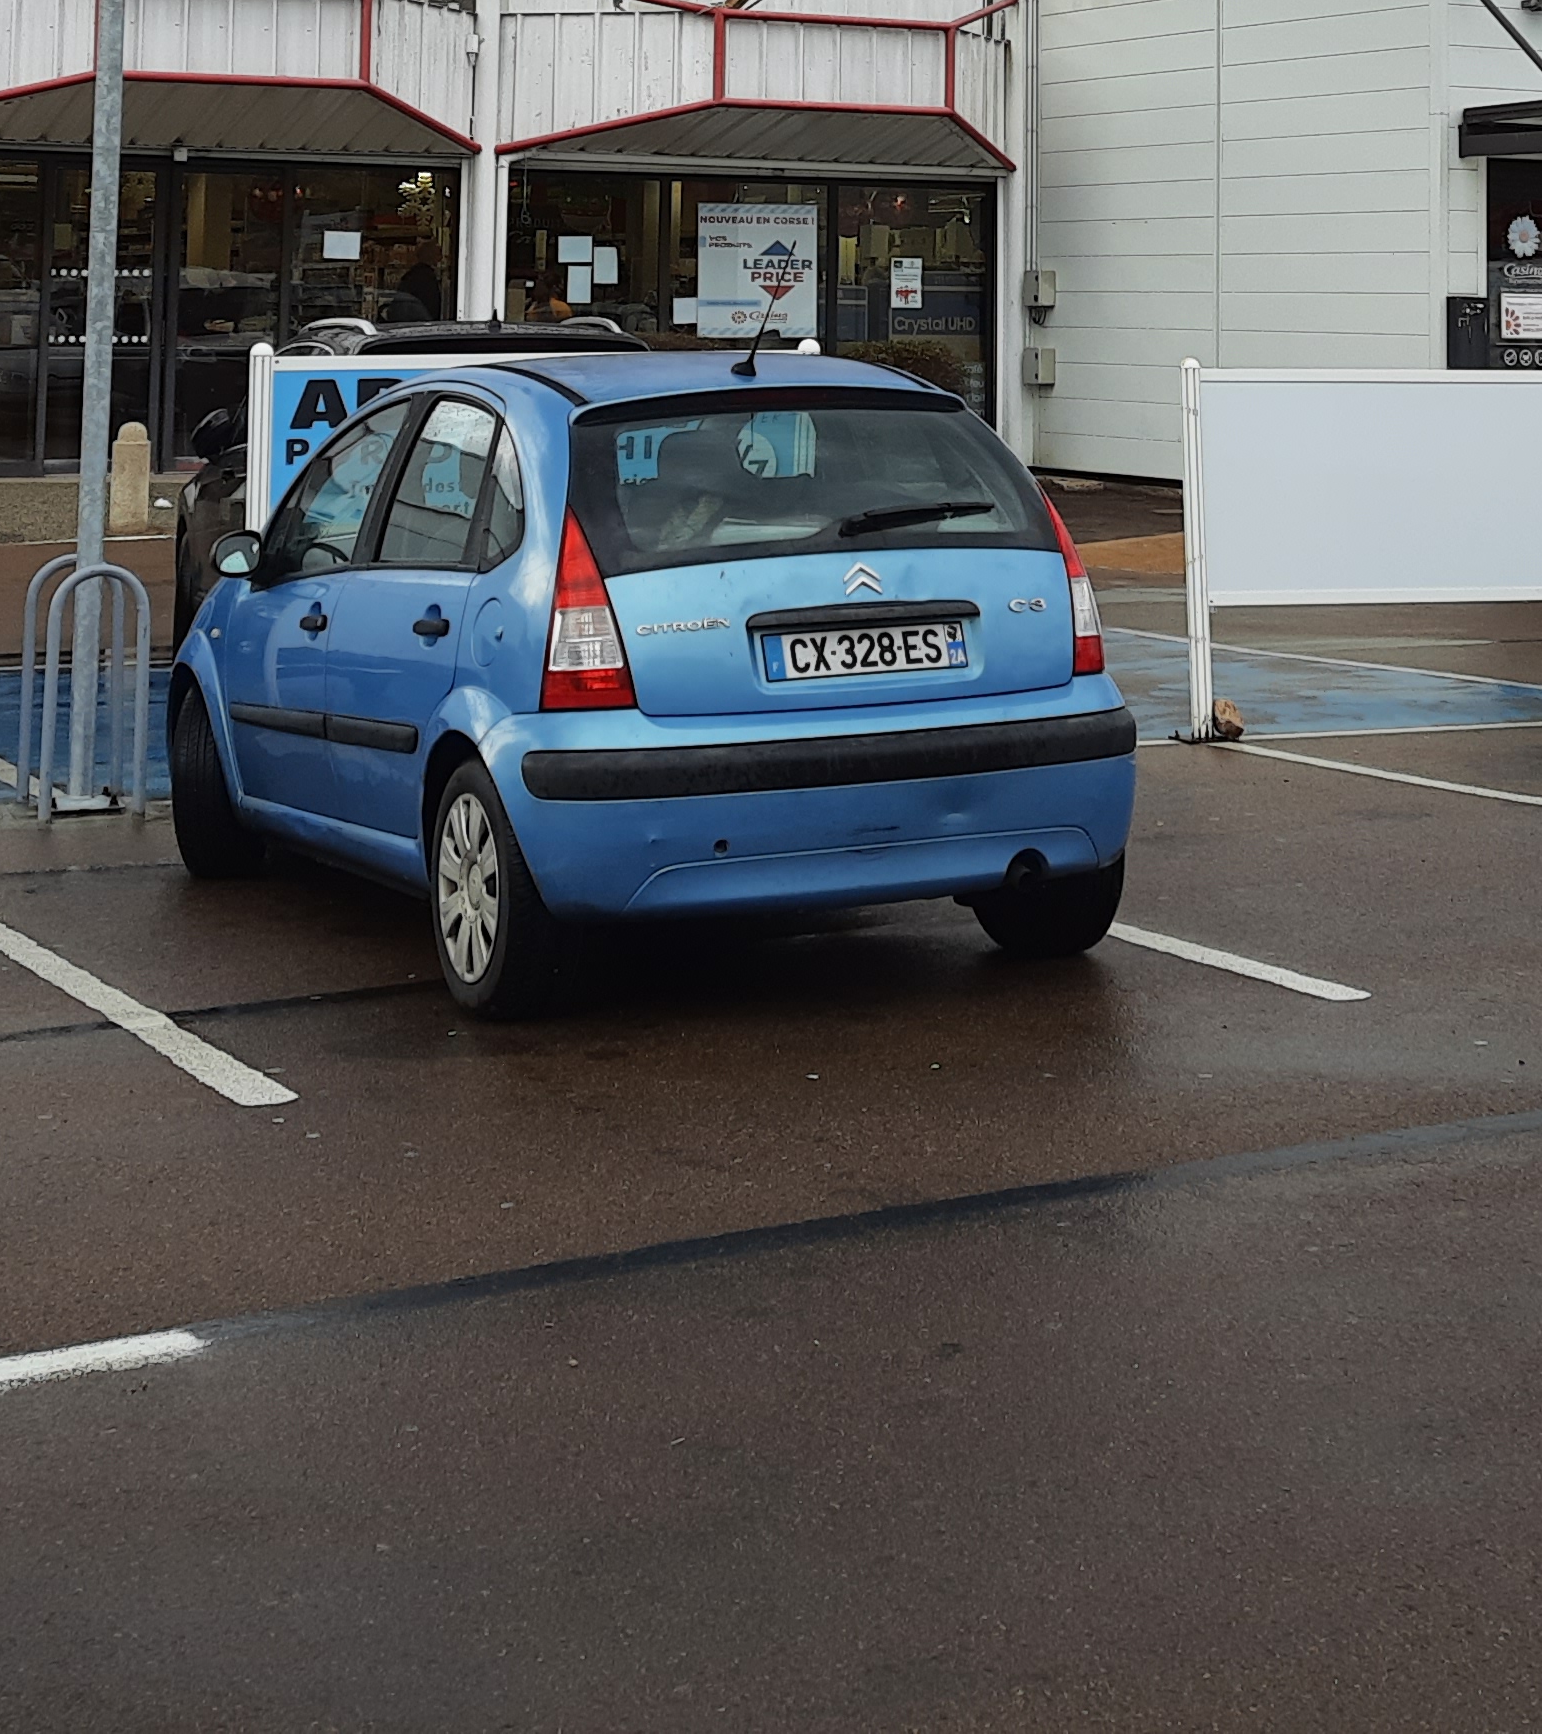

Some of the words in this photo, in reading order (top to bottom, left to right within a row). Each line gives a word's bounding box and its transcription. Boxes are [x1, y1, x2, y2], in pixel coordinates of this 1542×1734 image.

[699, 215, 753, 225] NOUVEAU
[756, 216, 770, 225] EN
[773, 217, 809, 225] CORSE
[742, 258, 813, 271] LEADER
[750, 271, 804, 283] PRICE
[893, 316, 946, 335] Crystal
[947, 316, 976, 331] UHD
[1008, 598, 1047, 613] C3
